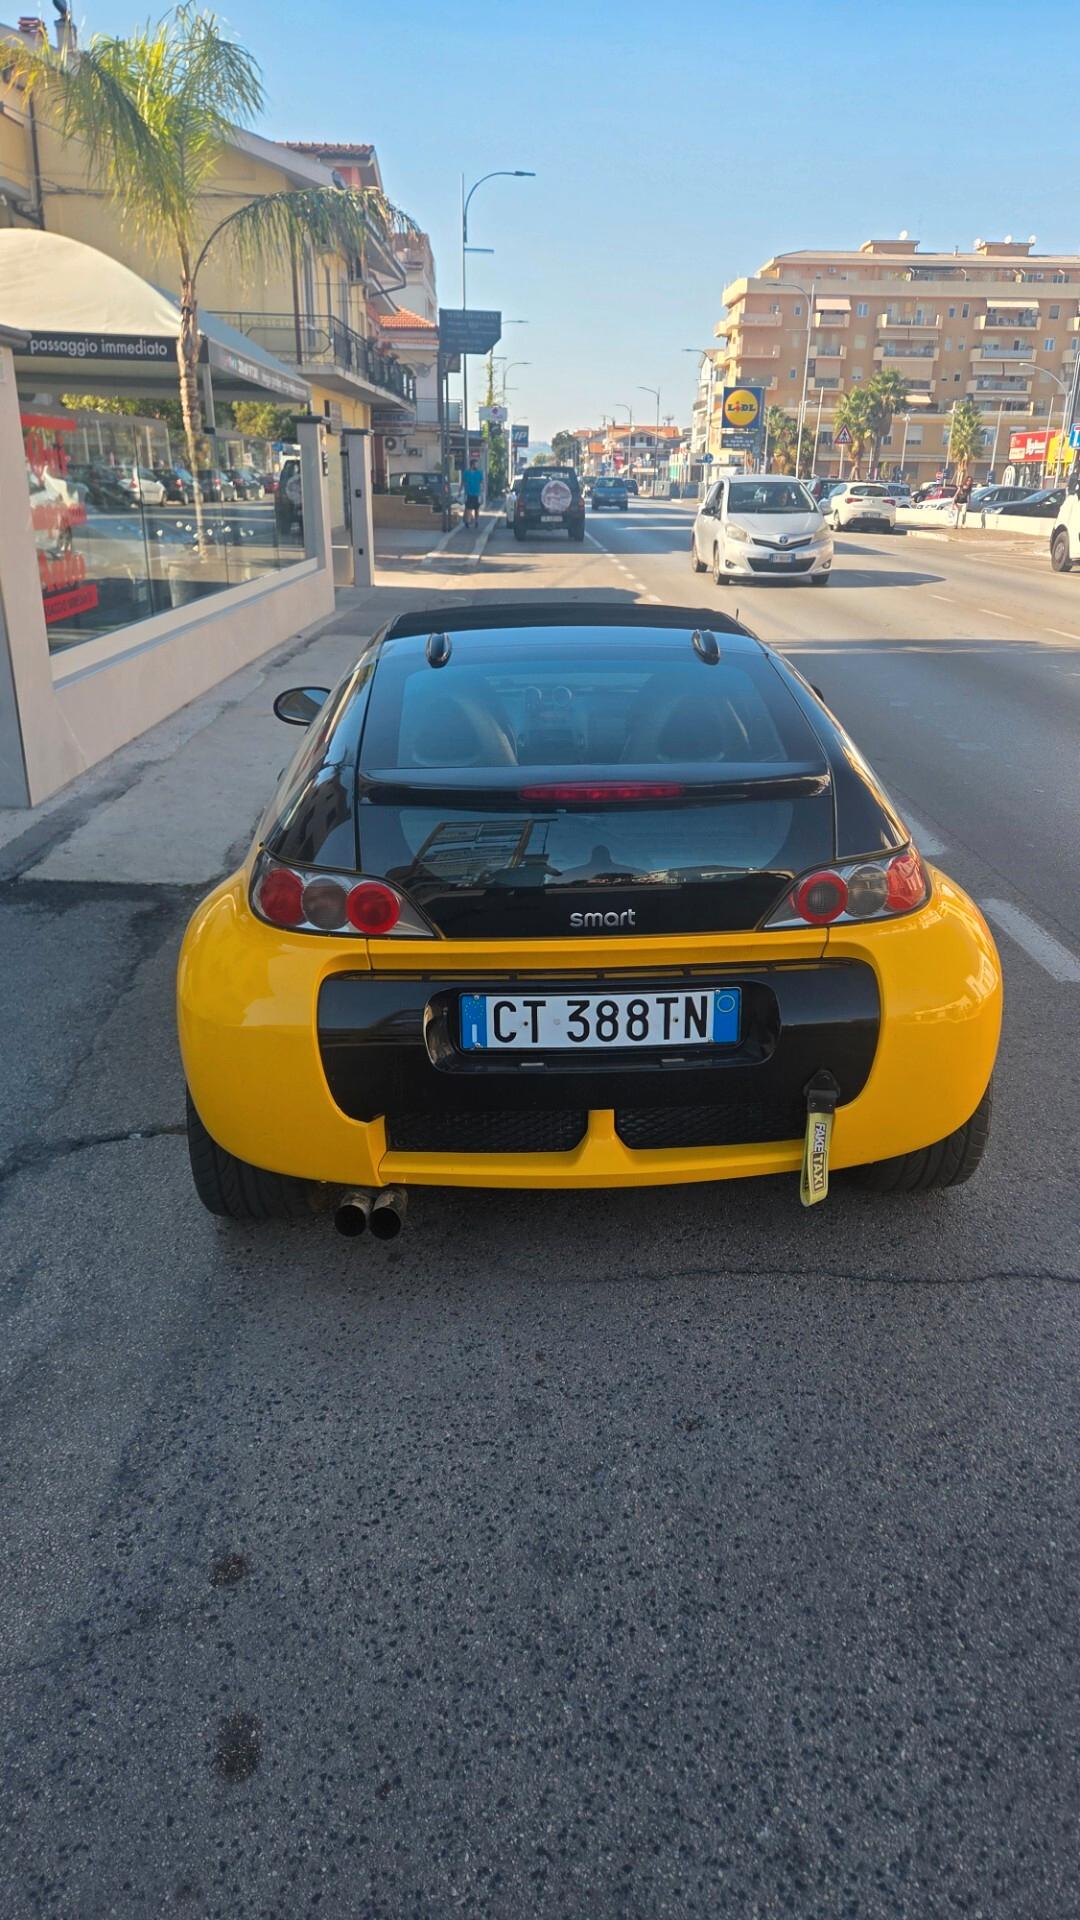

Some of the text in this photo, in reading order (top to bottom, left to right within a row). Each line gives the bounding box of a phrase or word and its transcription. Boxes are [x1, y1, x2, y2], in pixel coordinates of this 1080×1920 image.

[30, 338, 168, 357] passaggio immediato
[569, 908, 636, 928] smart
[493, 996, 708, 1044] CT 388TN
[813, 1122, 826, 1191] FAKE TAXI
